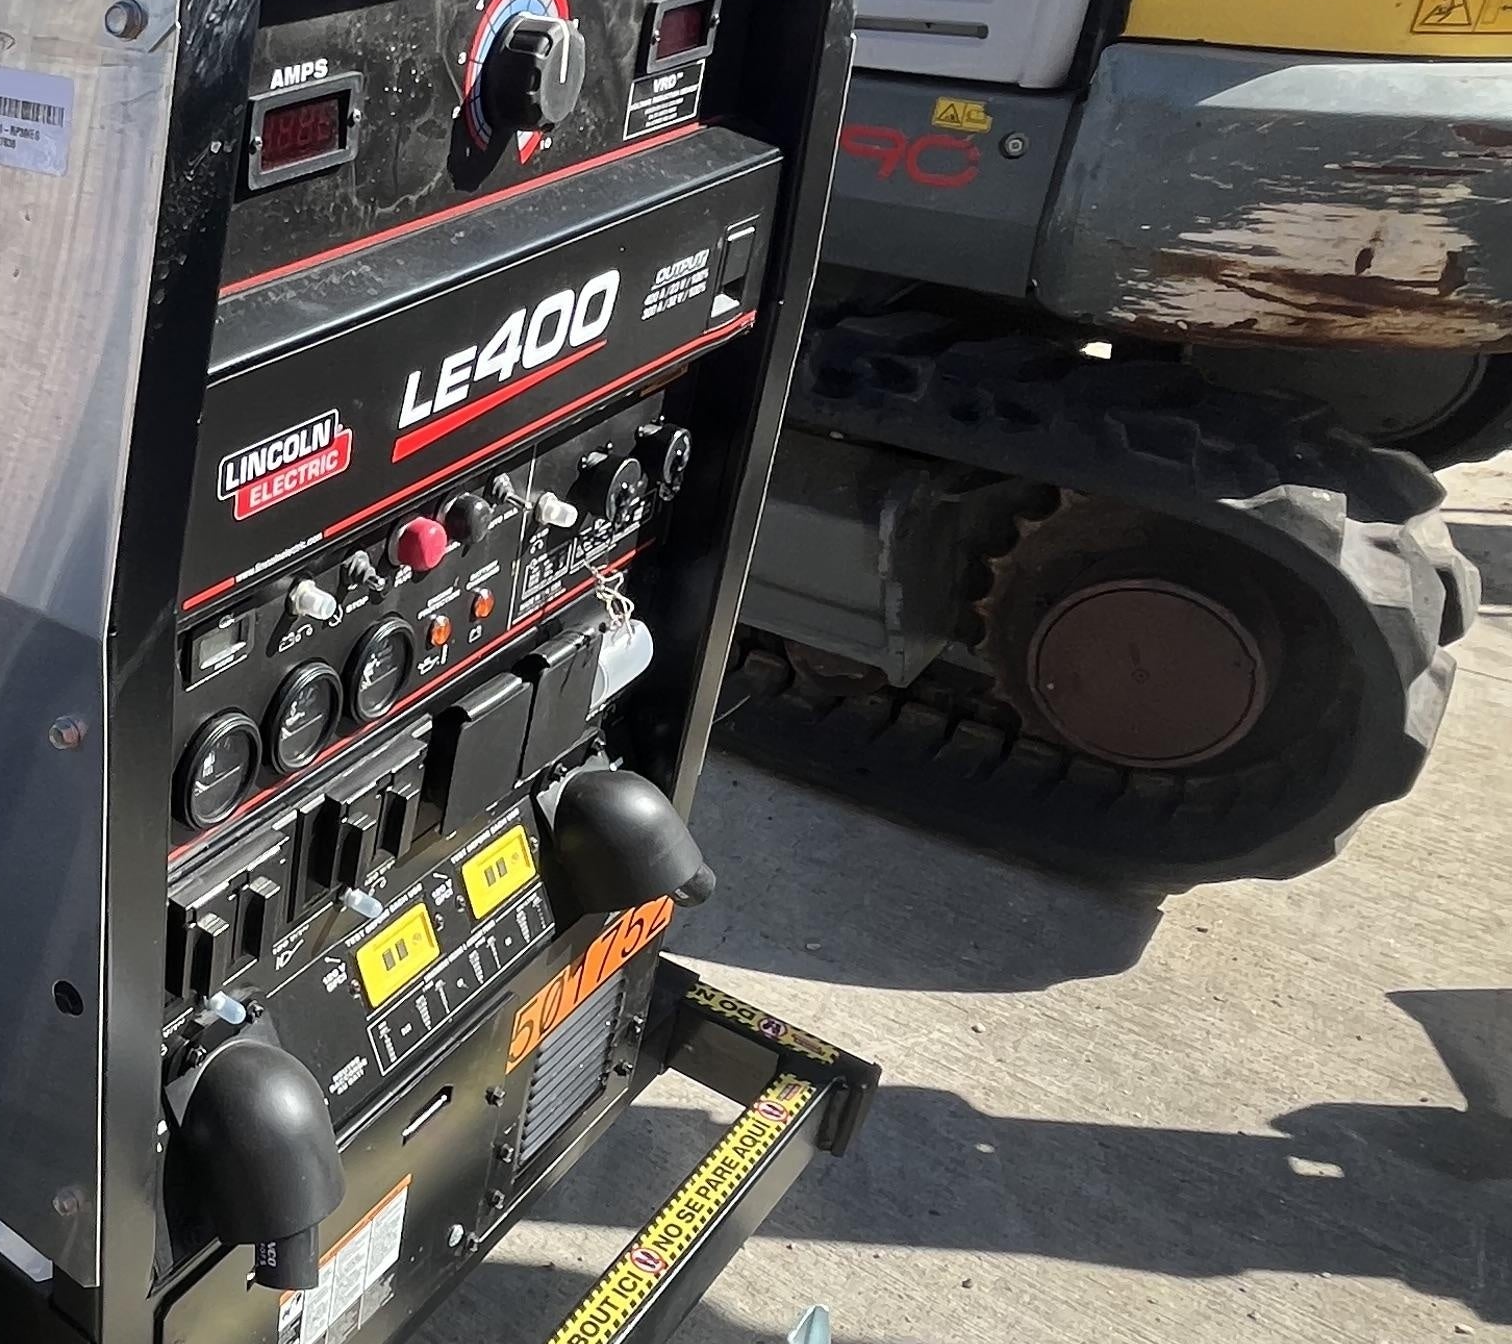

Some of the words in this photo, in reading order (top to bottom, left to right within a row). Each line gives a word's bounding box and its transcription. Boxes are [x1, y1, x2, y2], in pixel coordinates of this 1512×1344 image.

[269, 57, 329, 90] AMPS
[398, 269, 620, 429] LE400
[225, 419, 332, 492] LINCOLN
[249, 449, 340, 509] ELECTRIC
[719, 1000, 756, 1020] DO
[657, 1222, 686, 1256] NO
[679, 1196, 704, 1229] SE
[697, 1153, 740, 1203] PARE
[611, 1271, 642, 1306] ICI
